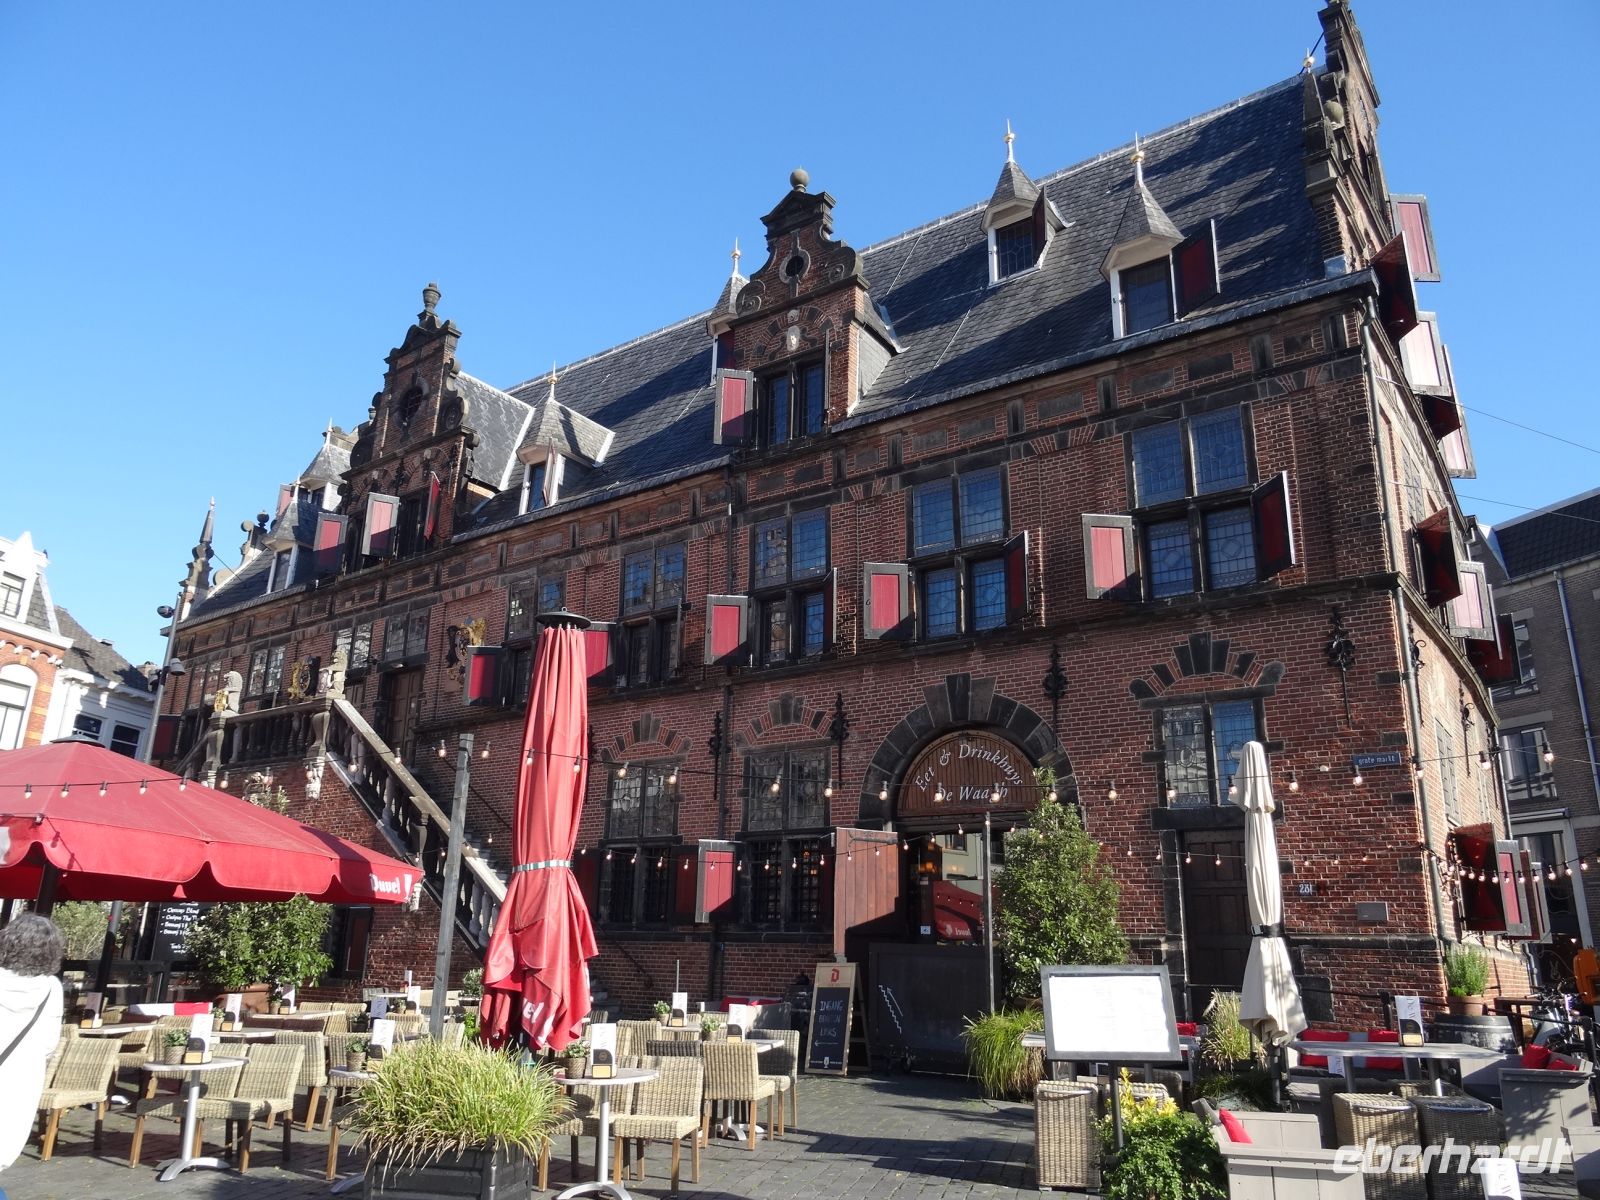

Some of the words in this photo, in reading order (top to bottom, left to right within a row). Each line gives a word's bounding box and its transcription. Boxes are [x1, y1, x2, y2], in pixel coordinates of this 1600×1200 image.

[915, 766, 935, 792] Eet
[940, 748, 951, 766] &
[958, 743, 1023, 785] Drinkhuys
[959, 781, 1008, 803] Waah
[369, 873, 401, 895] Duvel
